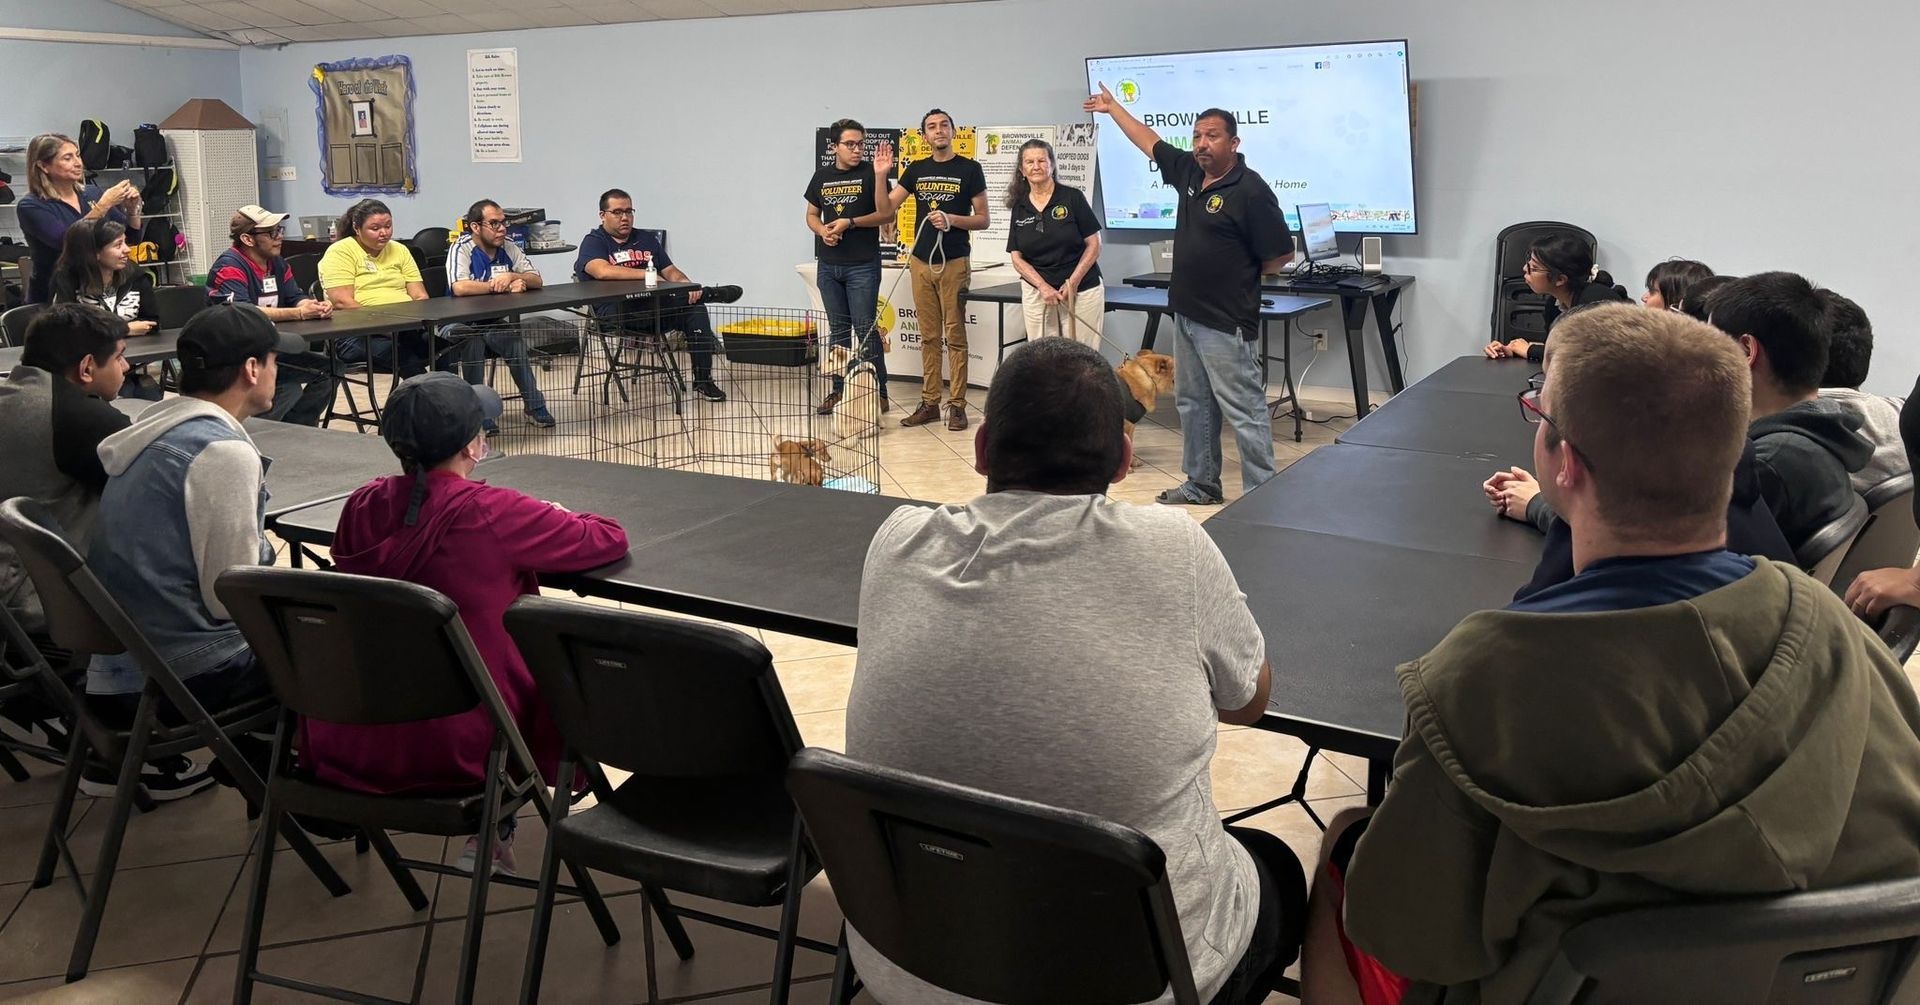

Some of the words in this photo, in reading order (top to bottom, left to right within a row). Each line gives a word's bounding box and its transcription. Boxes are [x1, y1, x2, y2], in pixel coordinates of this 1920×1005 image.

[1144, 110, 1269, 127] BROWLLE
[915, 182, 961, 193] VOLUNTEER
[1151, 181, 1158, 189] A
[1274, 180, 1308, 189] Home
[821, 185, 862, 196] VOLUNTEER
[823, 195, 858, 206] SQUAD
[918, 192, 955, 202] SQUAD
